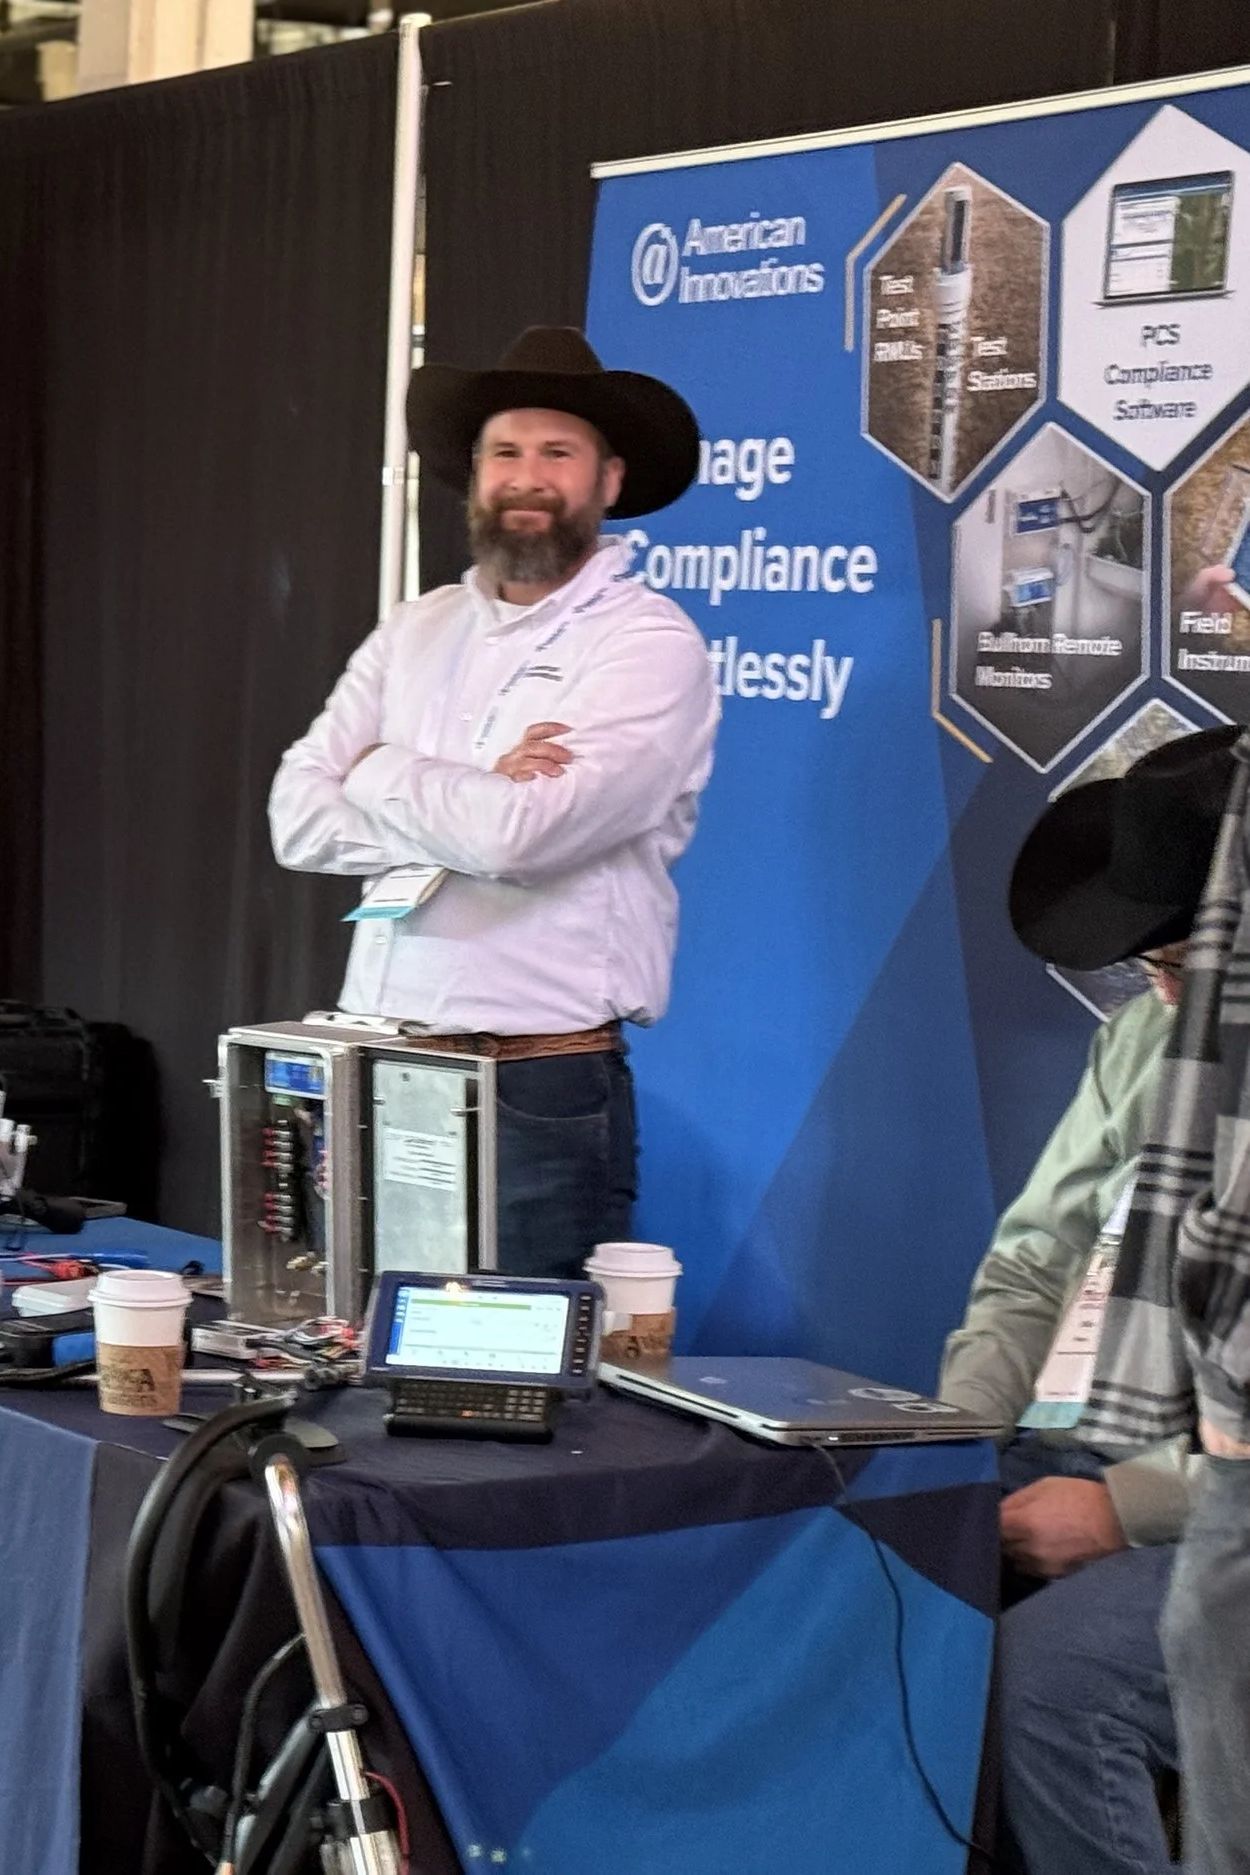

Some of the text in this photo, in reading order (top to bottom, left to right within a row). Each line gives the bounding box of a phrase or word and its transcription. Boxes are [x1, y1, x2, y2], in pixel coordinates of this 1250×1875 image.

[682, 211, 806, 256] American
[679, 257, 825, 304] Innovations
[1141, 323, 1181, 347] PCS
[1104, 361, 1213, 388] Compliance
[1113, 399, 1197, 421] Software
[1179, 611, 1232, 634] Field
[707, 636, 854, 719] tlessly
